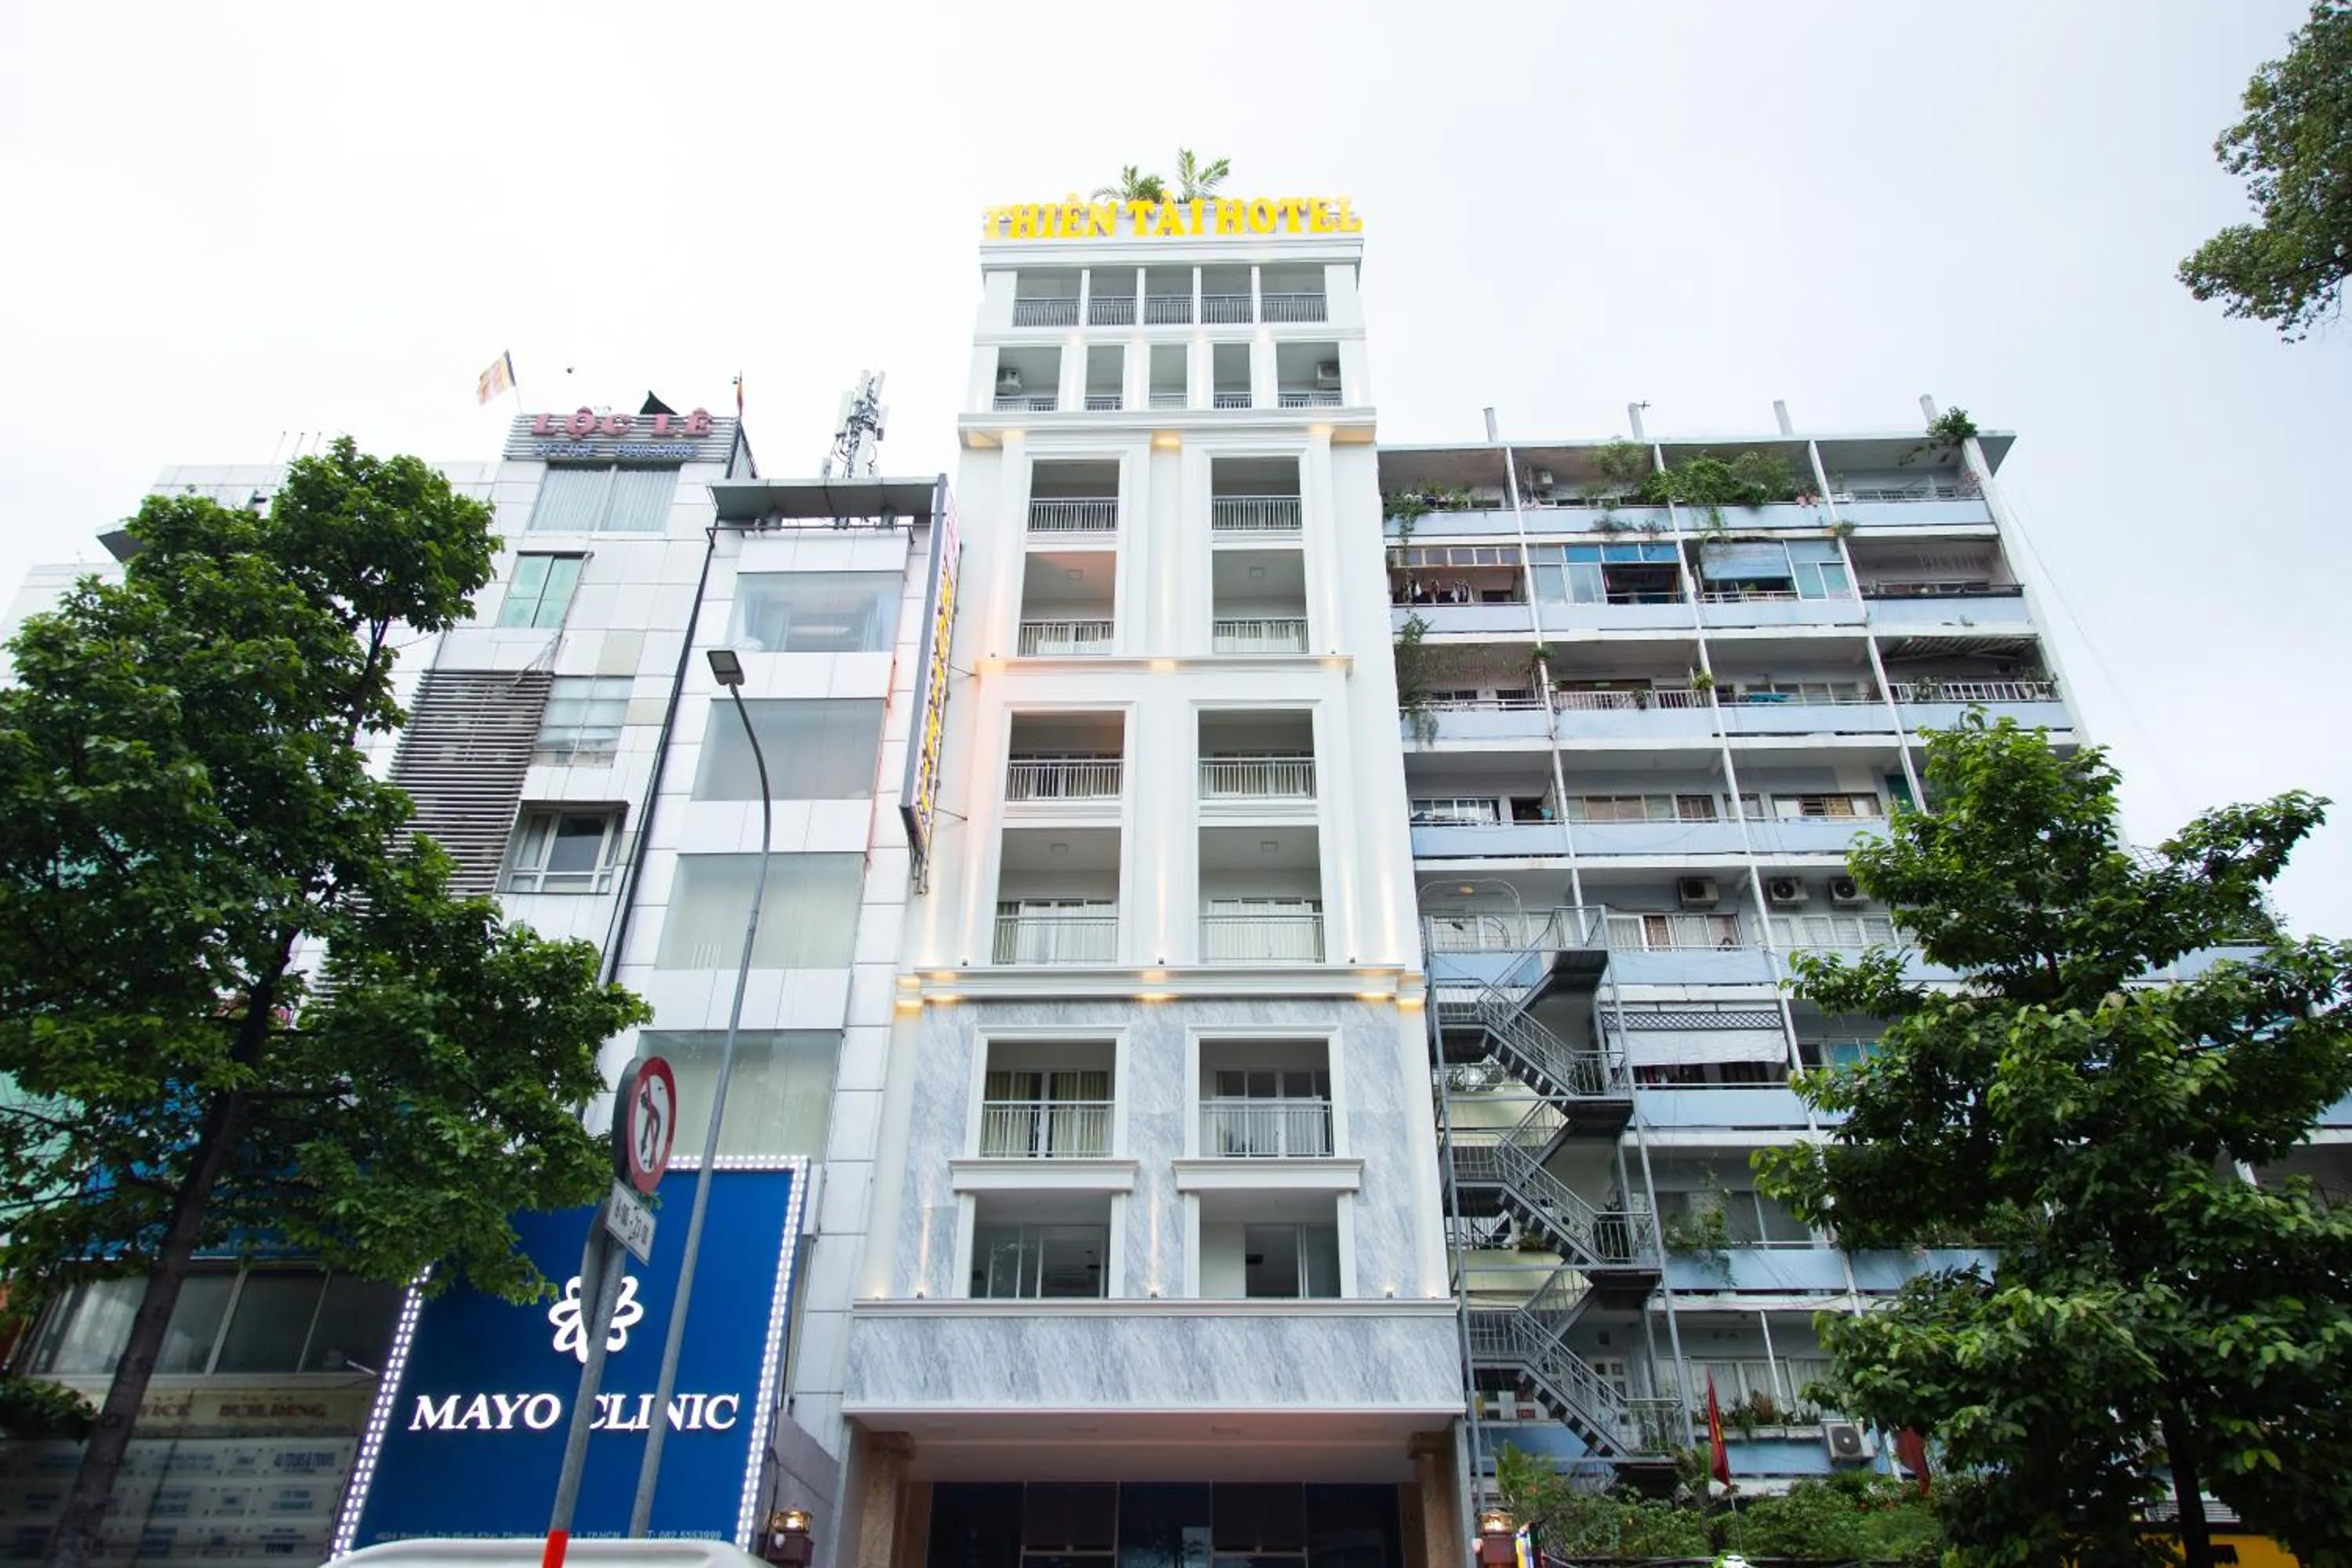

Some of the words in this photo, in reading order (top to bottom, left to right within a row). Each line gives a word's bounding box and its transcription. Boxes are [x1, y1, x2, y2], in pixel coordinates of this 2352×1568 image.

[1216, 194, 1363, 235] HOTEL
[408, 1392, 561, 1431] MAYO
[590, 1392, 739, 1432] CLINIC
